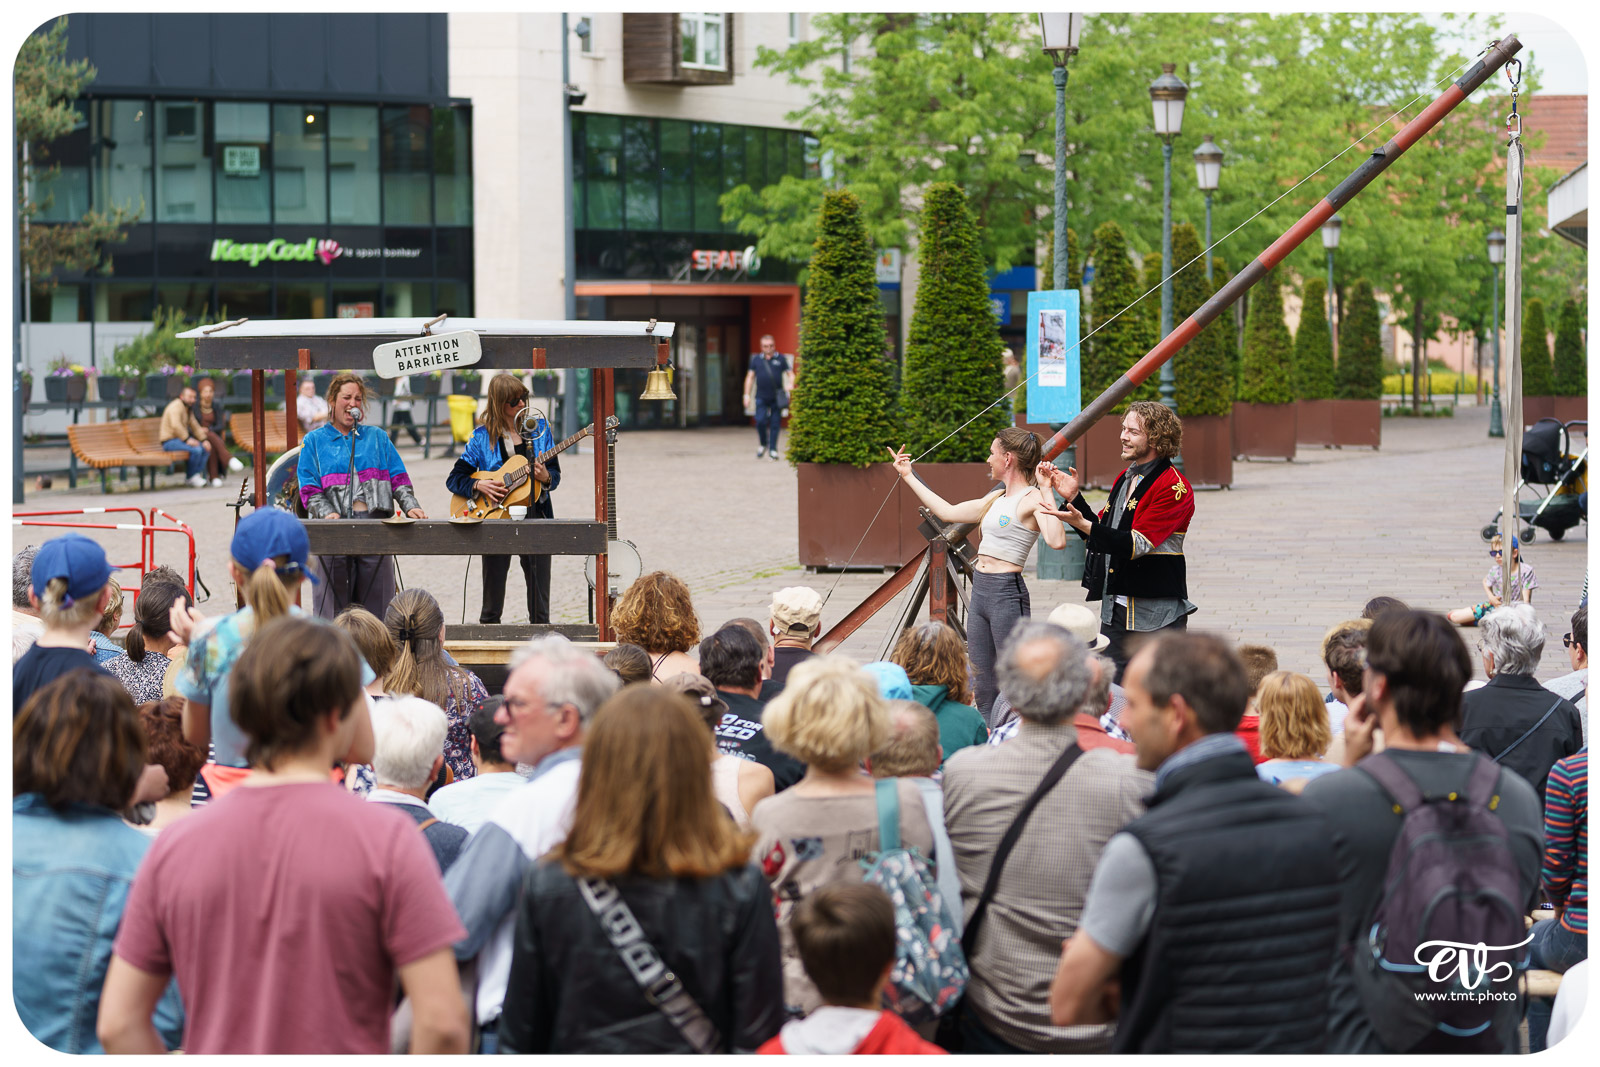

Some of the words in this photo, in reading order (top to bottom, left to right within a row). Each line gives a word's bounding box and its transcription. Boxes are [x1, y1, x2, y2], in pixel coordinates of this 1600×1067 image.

[211, 238, 317, 267] KeepCool
[344, 248, 353, 257] le
[356, 249, 381, 258] sport
[384, 248, 422, 257] bonheur
[692, 249, 744, 270] SPAR
[395, 338, 460, 358] ATTENTION
[398, 351, 460, 371] BARRIÈRE
[733, 718, 764, 731] FOR
